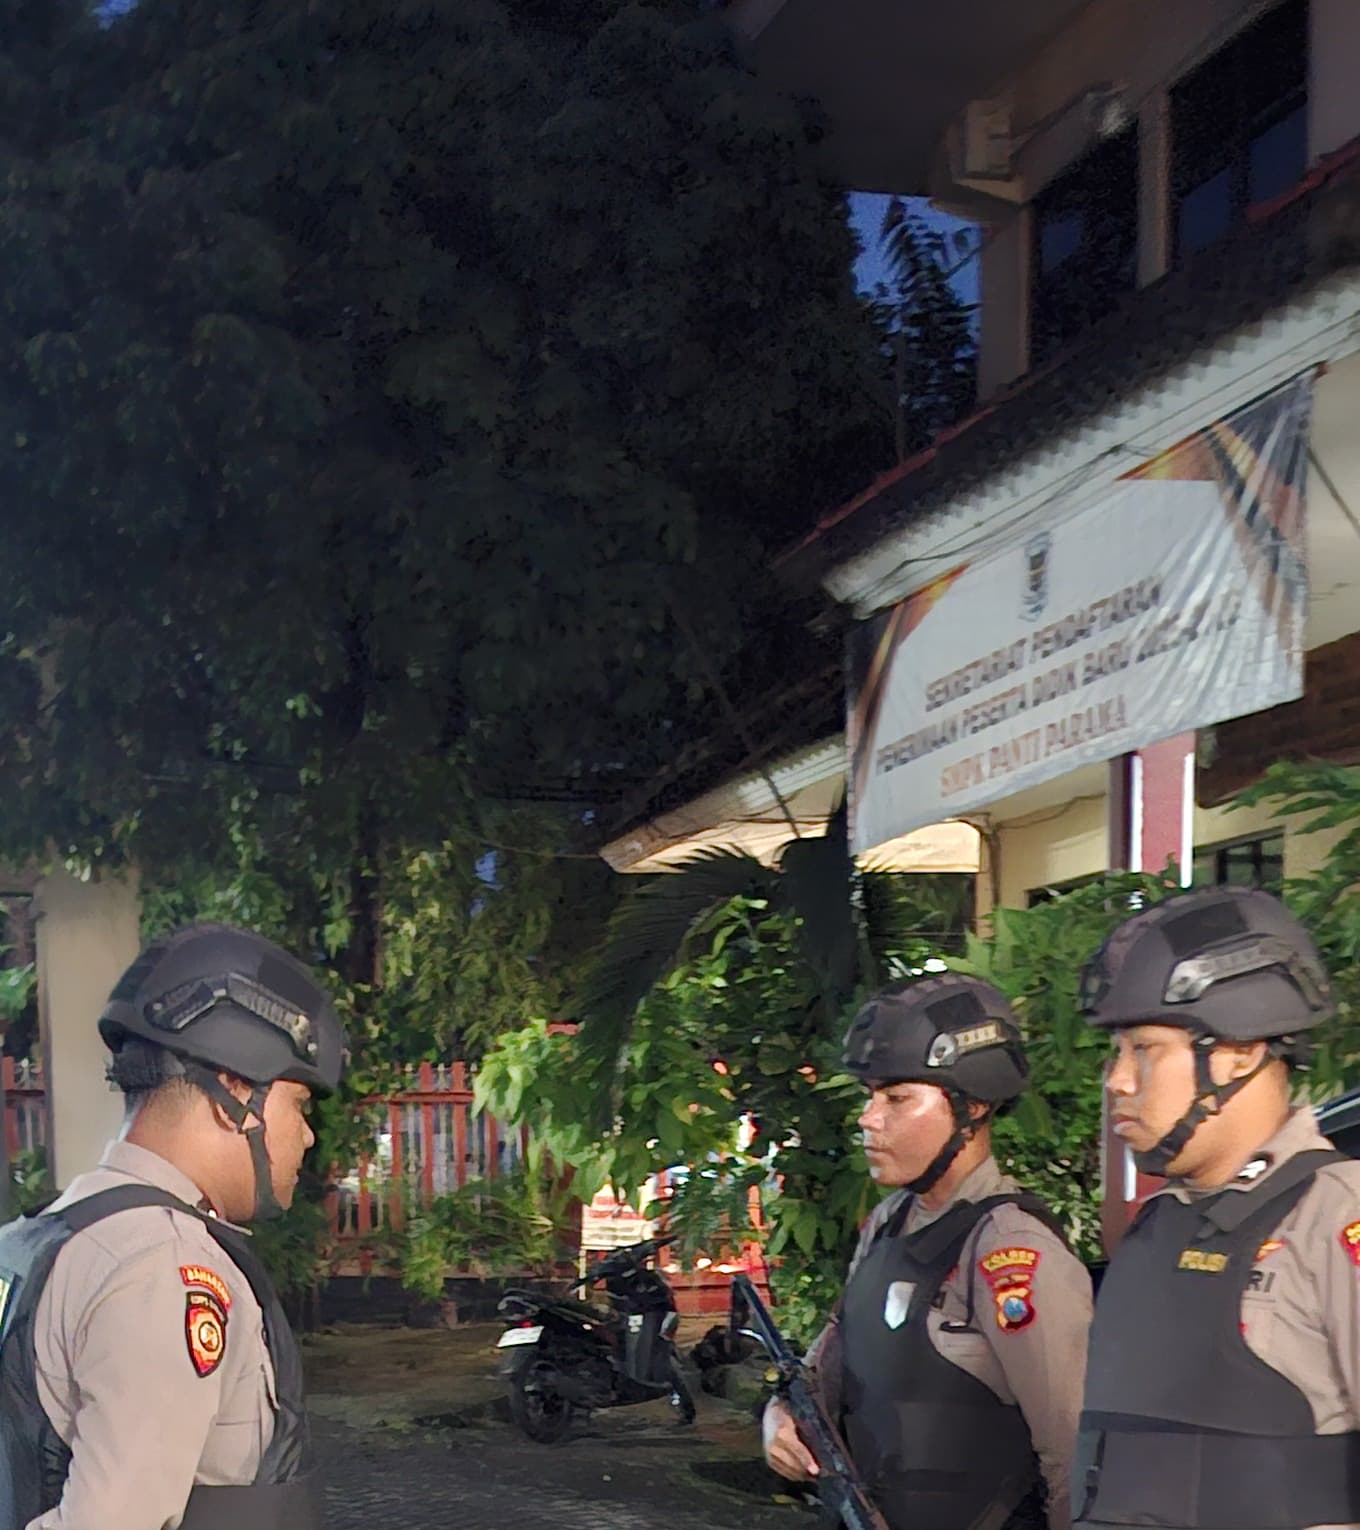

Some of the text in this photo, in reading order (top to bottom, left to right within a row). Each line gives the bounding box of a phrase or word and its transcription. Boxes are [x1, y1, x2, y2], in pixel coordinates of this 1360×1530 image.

[926, 639, 1027, 712] SEKRETARIAT
[1032, 580, 1161, 659] PENDAFTARAN
[1178, 1248, 1230, 1273] POLISI
